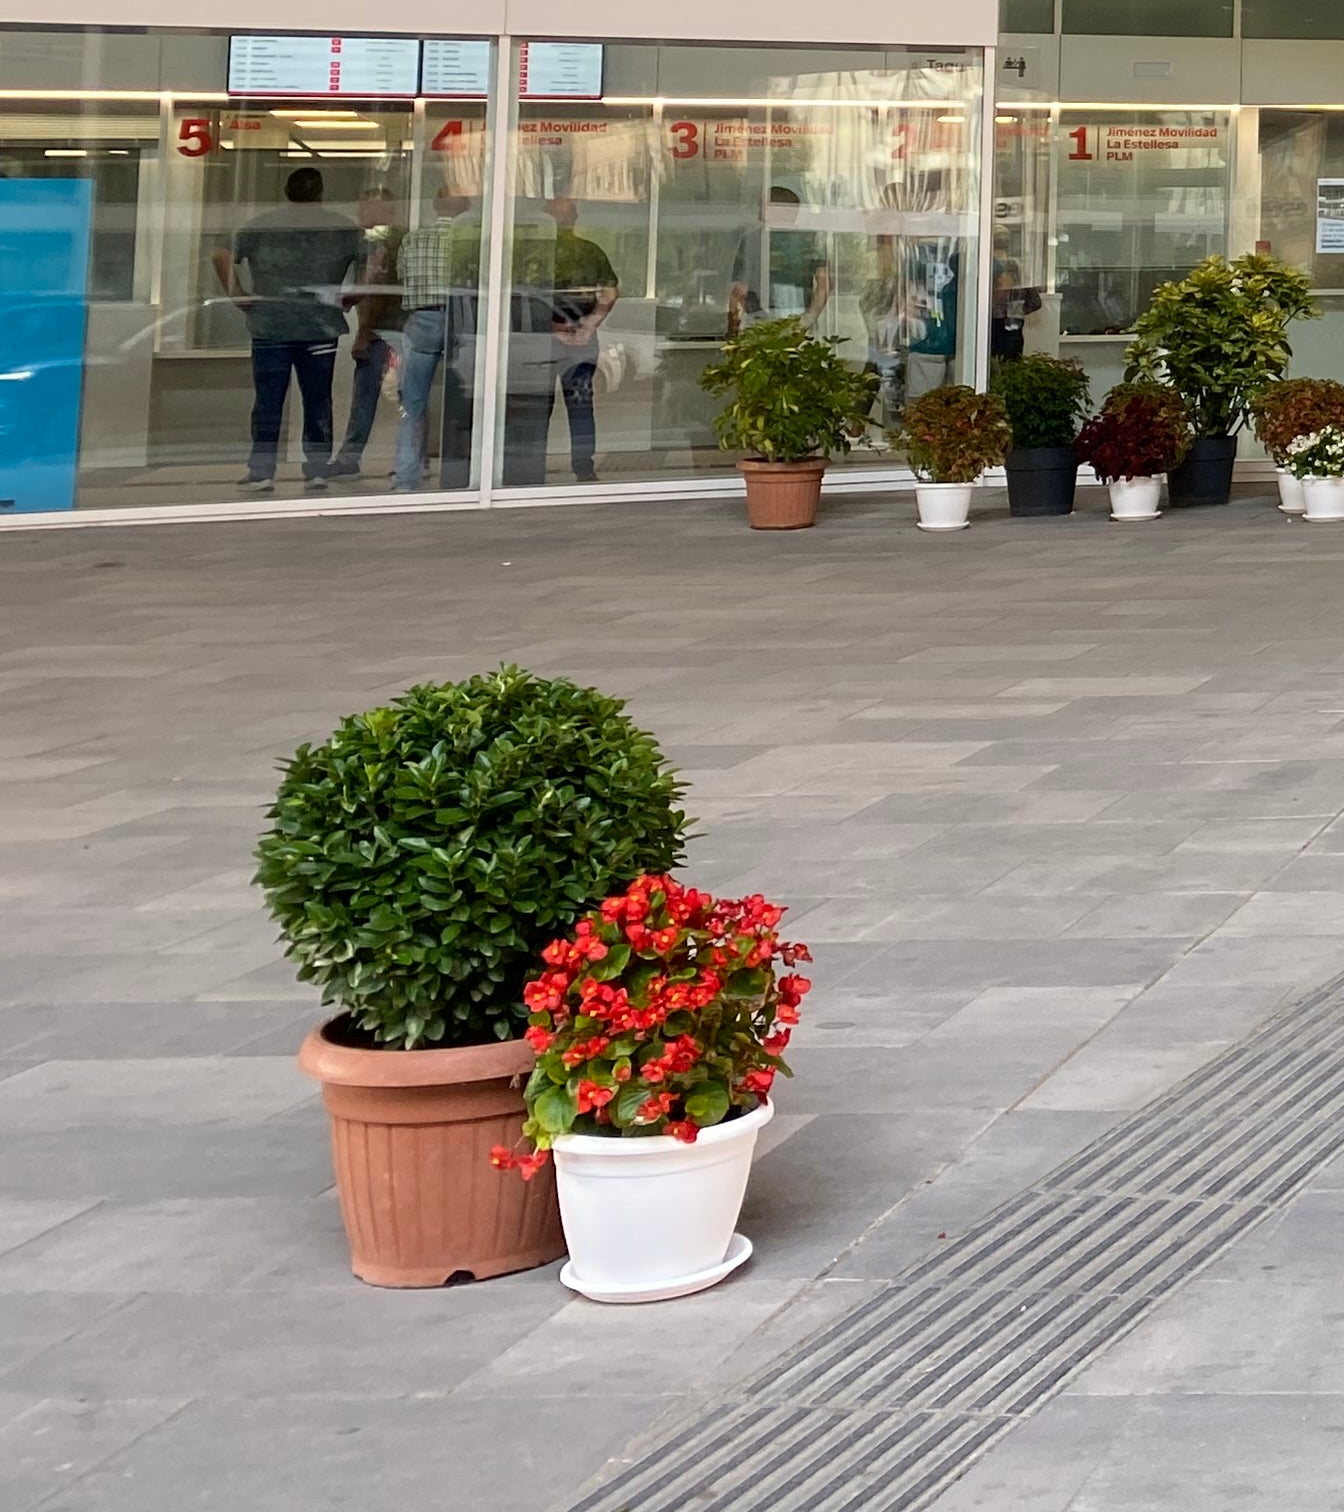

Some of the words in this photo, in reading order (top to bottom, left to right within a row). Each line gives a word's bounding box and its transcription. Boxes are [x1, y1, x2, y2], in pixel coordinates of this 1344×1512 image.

[540, 121, 608, 133] Movilidad
[713, 123, 768, 134] Jiménez
[1106, 127, 1157, 138] Jiménez
[1158, 127, 1218, 138] Movilidad
[177, 119, 212, 158] 5
[431, 120, 467, 153] 4
[670, 121, 699, 159] 3
[713, 137, 730, 148] La
[891, 123, 918, 160] 2
[1068, 126, 1093, 161] 1
[1106, 140, 1121, 150] La
[1123, 140, 1180, 150] Estellesa
[1106, 151, 1134, 162] PLM
